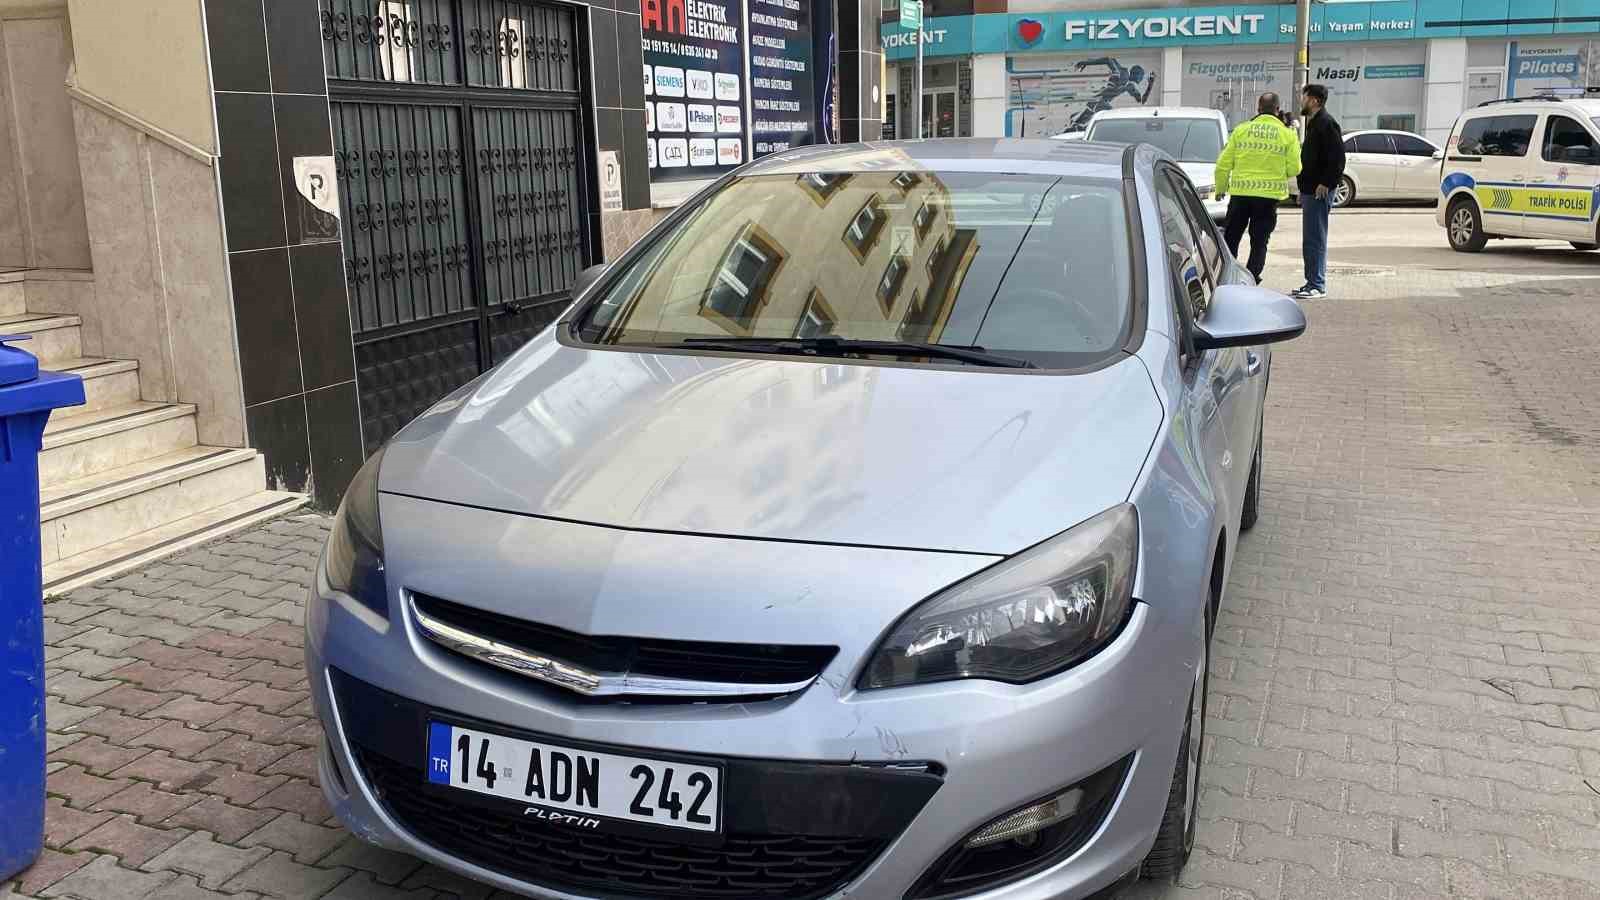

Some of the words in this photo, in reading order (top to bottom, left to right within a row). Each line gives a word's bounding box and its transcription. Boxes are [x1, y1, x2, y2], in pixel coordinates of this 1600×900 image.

[1328, 20, 1364, 33] Yaşam
[1370, 19, 1414, 31] Merkezi
[1189, 62, 1265, 77] Fizyoterapi
[1316, 66, 1361, 82] Masaj
[1520, 61, 1575, 75] Pilates
[656, 75, 683, 89] SIEMENS
[1528, 194, 1556, 209] TRAFİK
[1559, 195, 1586, 210] POLİSİ
[432, 756, 449, 774] TR
[457, 734, 497, 789] 14
[524, 747, 600, 809] ADN
[629, 764, 713, 825] 242
